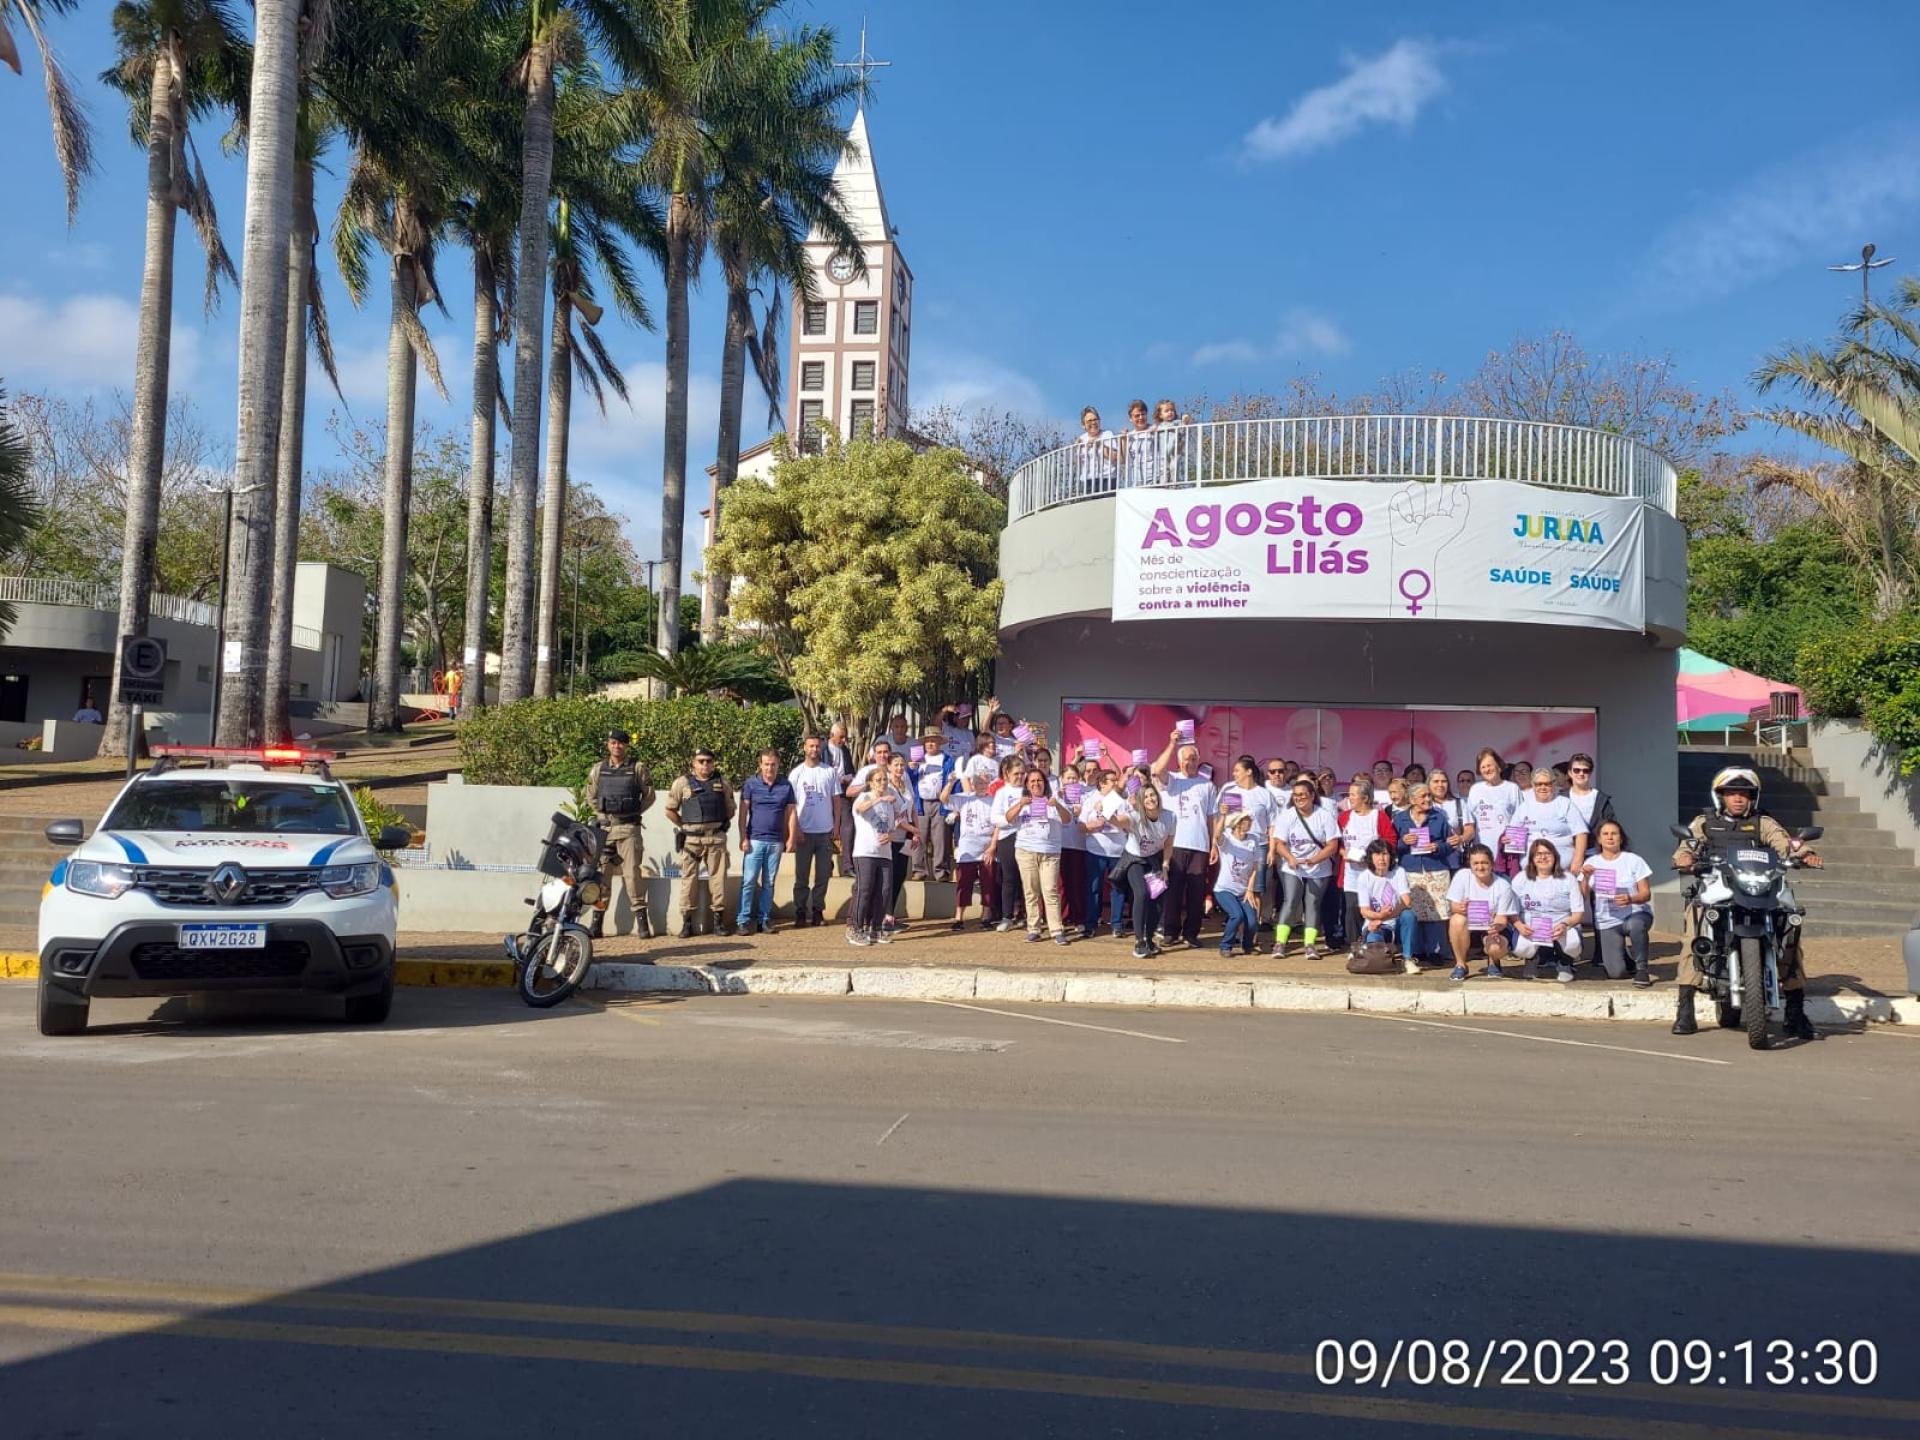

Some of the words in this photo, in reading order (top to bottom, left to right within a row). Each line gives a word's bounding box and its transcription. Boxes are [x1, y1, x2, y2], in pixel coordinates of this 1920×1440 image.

[1140, 495, 1364, 549] Agosto
[1140, 555, 1165, 566] Mês
[1167, 553, 1183, 564] de
[1267, 539, 1369, 574] Lilás
[1139, 566, 1242, 581] conscientização
[1489, 566, 1552, 585] SAÚDE
[1570, 573, 1620, 593] SAÚDE
[1138, 583, 1173, 595] sobre
[1175, 585, 1183, 594] a
[1186, 581, 1251, 593] violência
[1138, 598, 1181, 610] contra
[1184, 600, 1193, 608] a
[1196, 597, 1248, 608] mulher
[136, 644, 154, 668] E
